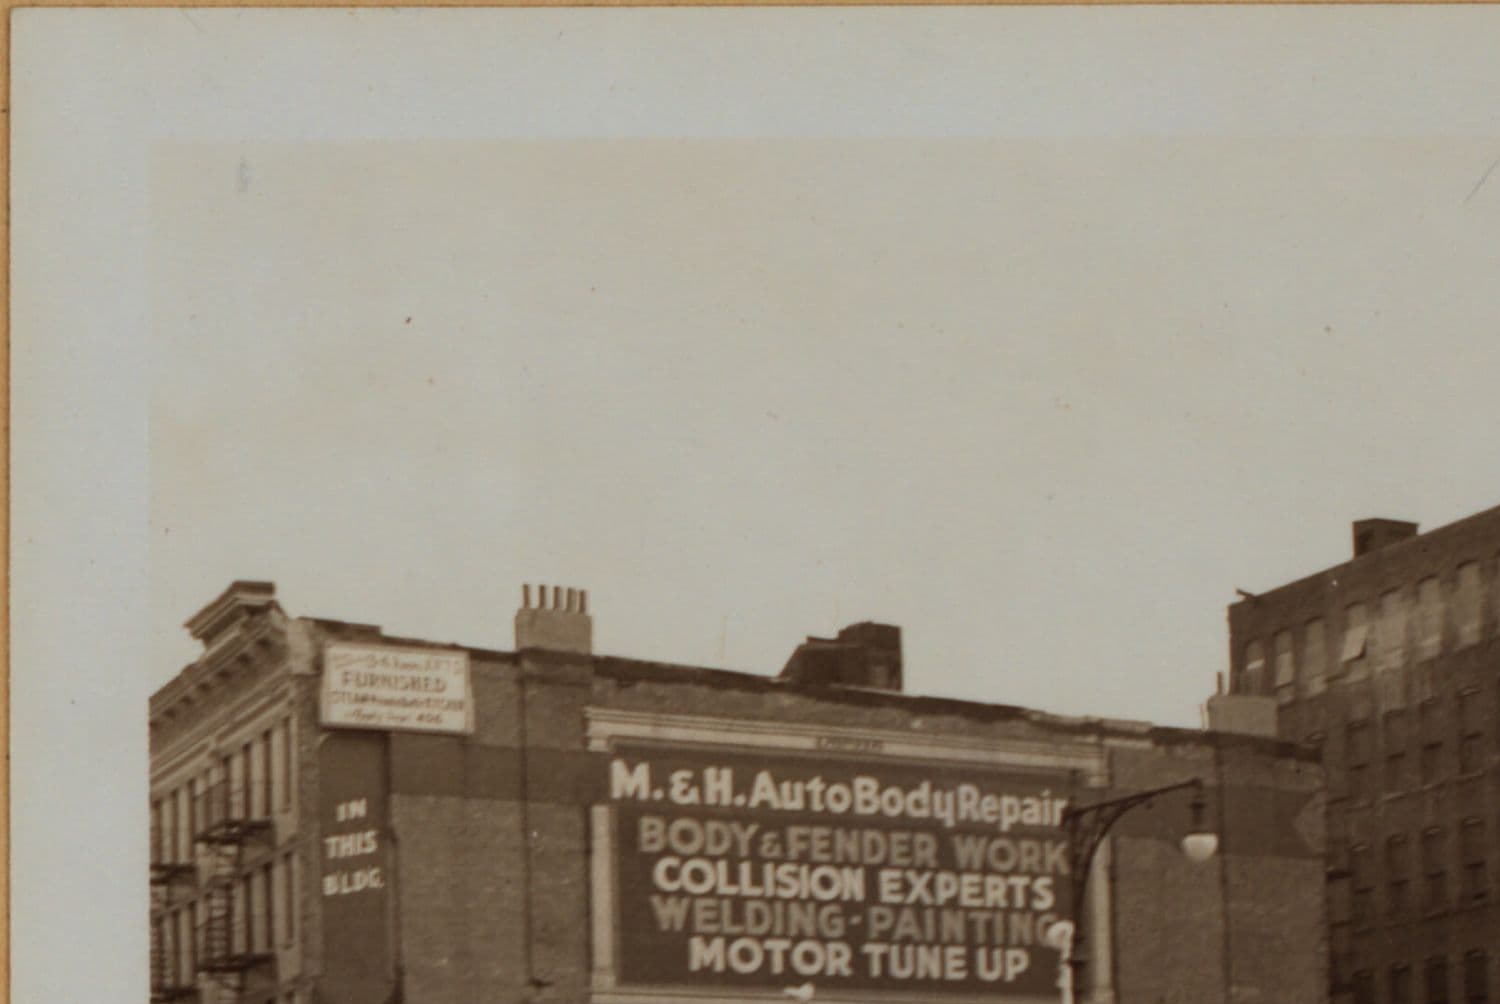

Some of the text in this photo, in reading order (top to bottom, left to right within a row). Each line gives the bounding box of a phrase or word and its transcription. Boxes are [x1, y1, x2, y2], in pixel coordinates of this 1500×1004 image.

[341, 670, 447, 693] FURNISHED
[336, 797, 367, 822] IN
[324, 829, 379, 860] THIS
[638, 814, 758, 857] BODY
[785, 824, 937, 869] FENDER
[953, 834, 1070, 875] WORK
[653, 855, 1055, 911] COLLISION EXPERTS
[688, 934, 1029, 983] MOTOR TUNE UP
